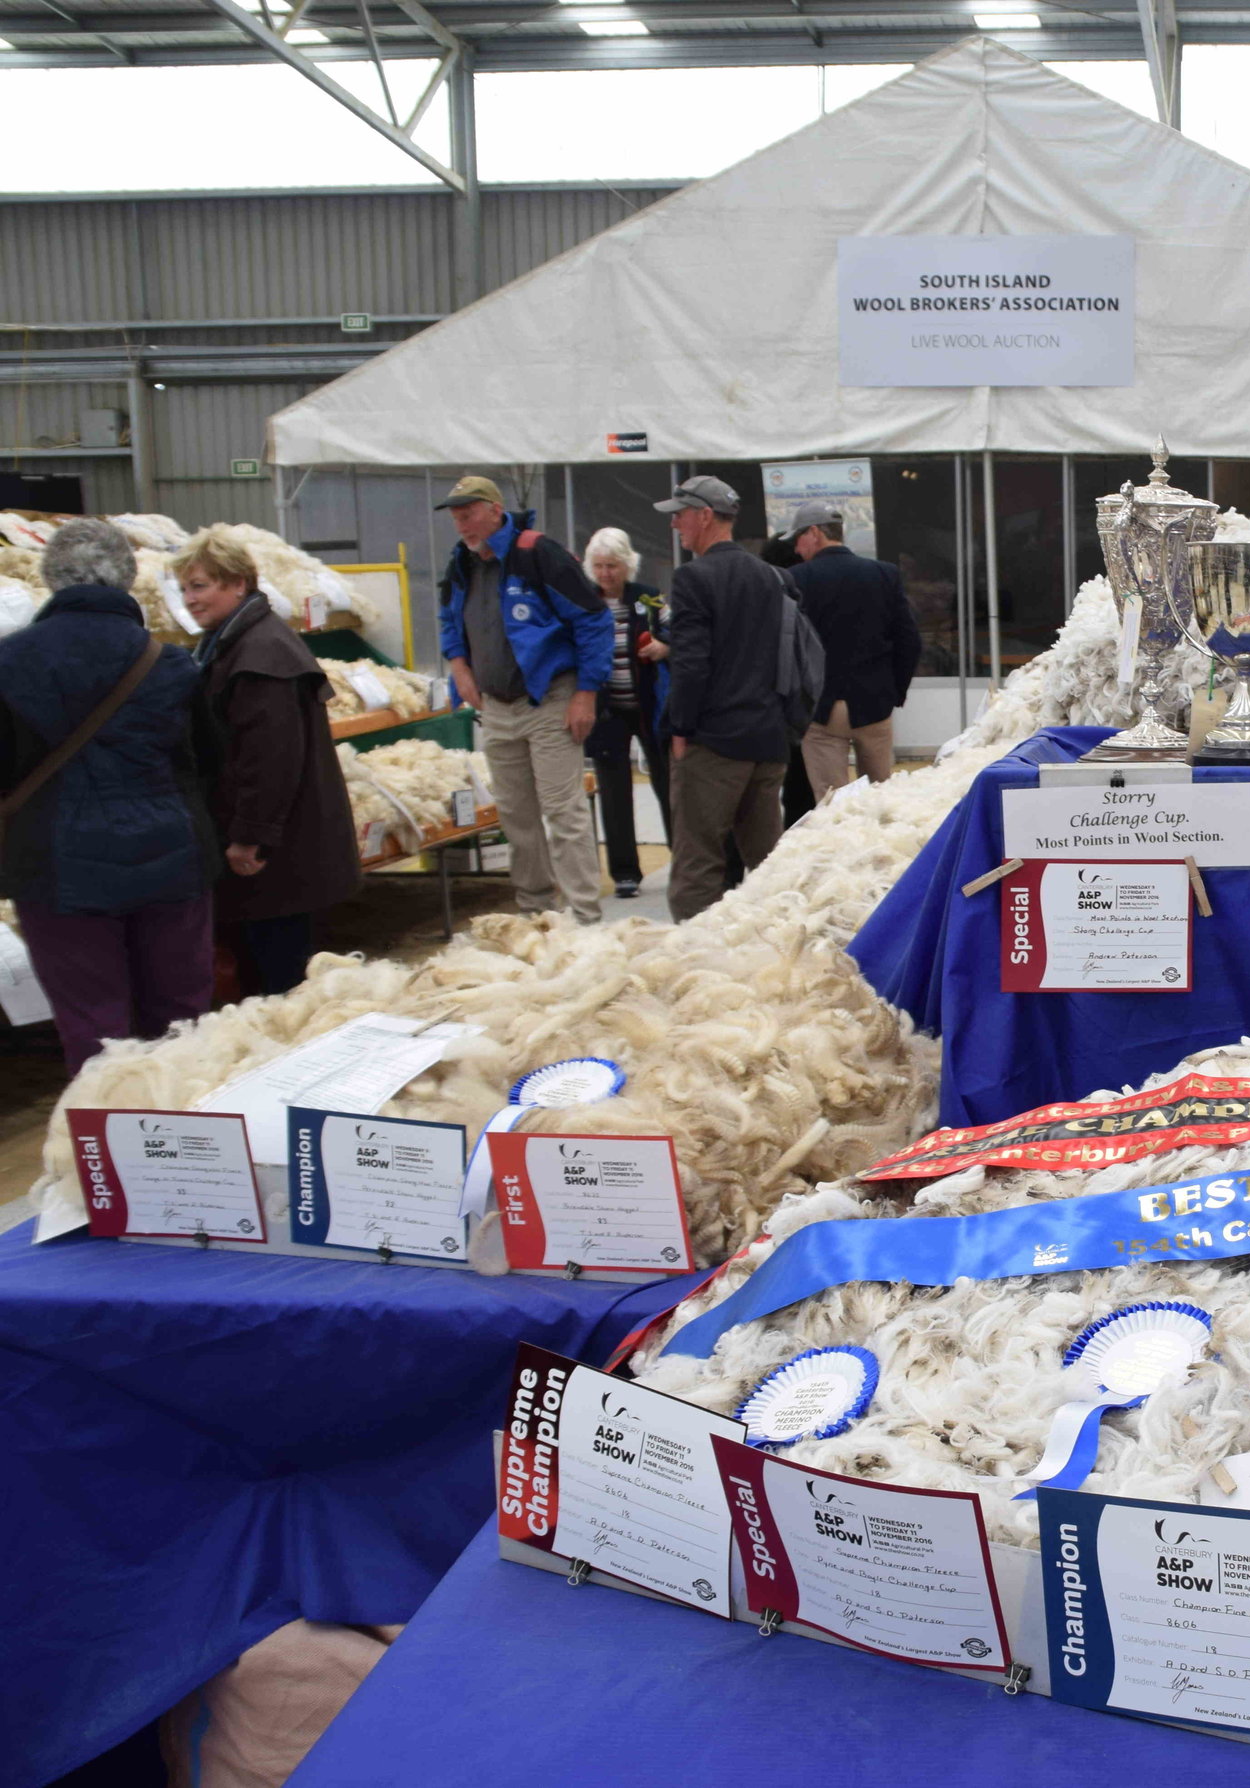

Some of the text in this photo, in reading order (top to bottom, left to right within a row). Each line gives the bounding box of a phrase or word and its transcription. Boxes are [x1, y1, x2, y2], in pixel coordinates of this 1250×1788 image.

[919, 274, 1052, 289] SOUTH ISLAND
[853, 296, 1120, 312] WOOL BROKERS' ASSOCIATION
[911, 334, 1061, 349] LIVE WOOL AUCTION
[1102, 790, 1156, 807] Storry
[1070, 810, 1190, 829] Challenge Cup.
[1035, 830, 1225, 850] Most Points in Wool Section.
[1077, 890, 1102, 900] A&P
[1077, 901, 1113, 910] SHOW
[1009, 886, 1033, 965] Special
[144, 1140, 166, 1148] A&P
[357, 1147, 379, 1157] A&P
[145, 1149, 178, 1159] SHOW
[956, 1138, 1166, 1167] Canterbury
[356, 1157, 390, 1169] SHOW
[564, 1166, 586, 1176] A&P
[77, 1136, 113, 1211] Special
[296, 1127, 316, 1226] Champion
[564, 1176, 599, 1186] SHOW
[502, 1175, 527, 1226] First
[1111, 1227, 1213, 1256] 154th
[774, 1408, 825, 1417] CHAMPION
[774, 1416, 812, 1424] MERINO
[595, 1425, 624, 1444] A&P
[502, 1367, 538, 1519] Supreme
[525, 1367, 566, 1538] Champion
[592, 1440, 636, 1465] SHOW
[813, 1510, 845, 1527] A&P
[868, 1515, 916, 1529] WEDNESDAY
[729, 1476, 775, 1581] Special
[815, 1523, 863, 1546] SHOW
[869, 1522, 881, 1530] TO
[881, 1525, 909, 1535] FRIDAY
[871, 1530, 933, 1545] NOVEMBER 2016
[1155, 1545, 1213, 1559] CANTERBURY
[1156, 1555, 1194, 1573] A&P
[1223, 1562, 1236, 1570] TO
[1156, 1572, 1214, 1593] SHOW
[1056, 1522, 1087, 1677] Champion
[1173, 1598, 1221, 1614] Champion
[1225, 1604, 1247, 1617] Fine
[1166, 1617, 1197, 1629] 8606
[1205, 1645, 1218, 1655] 18
